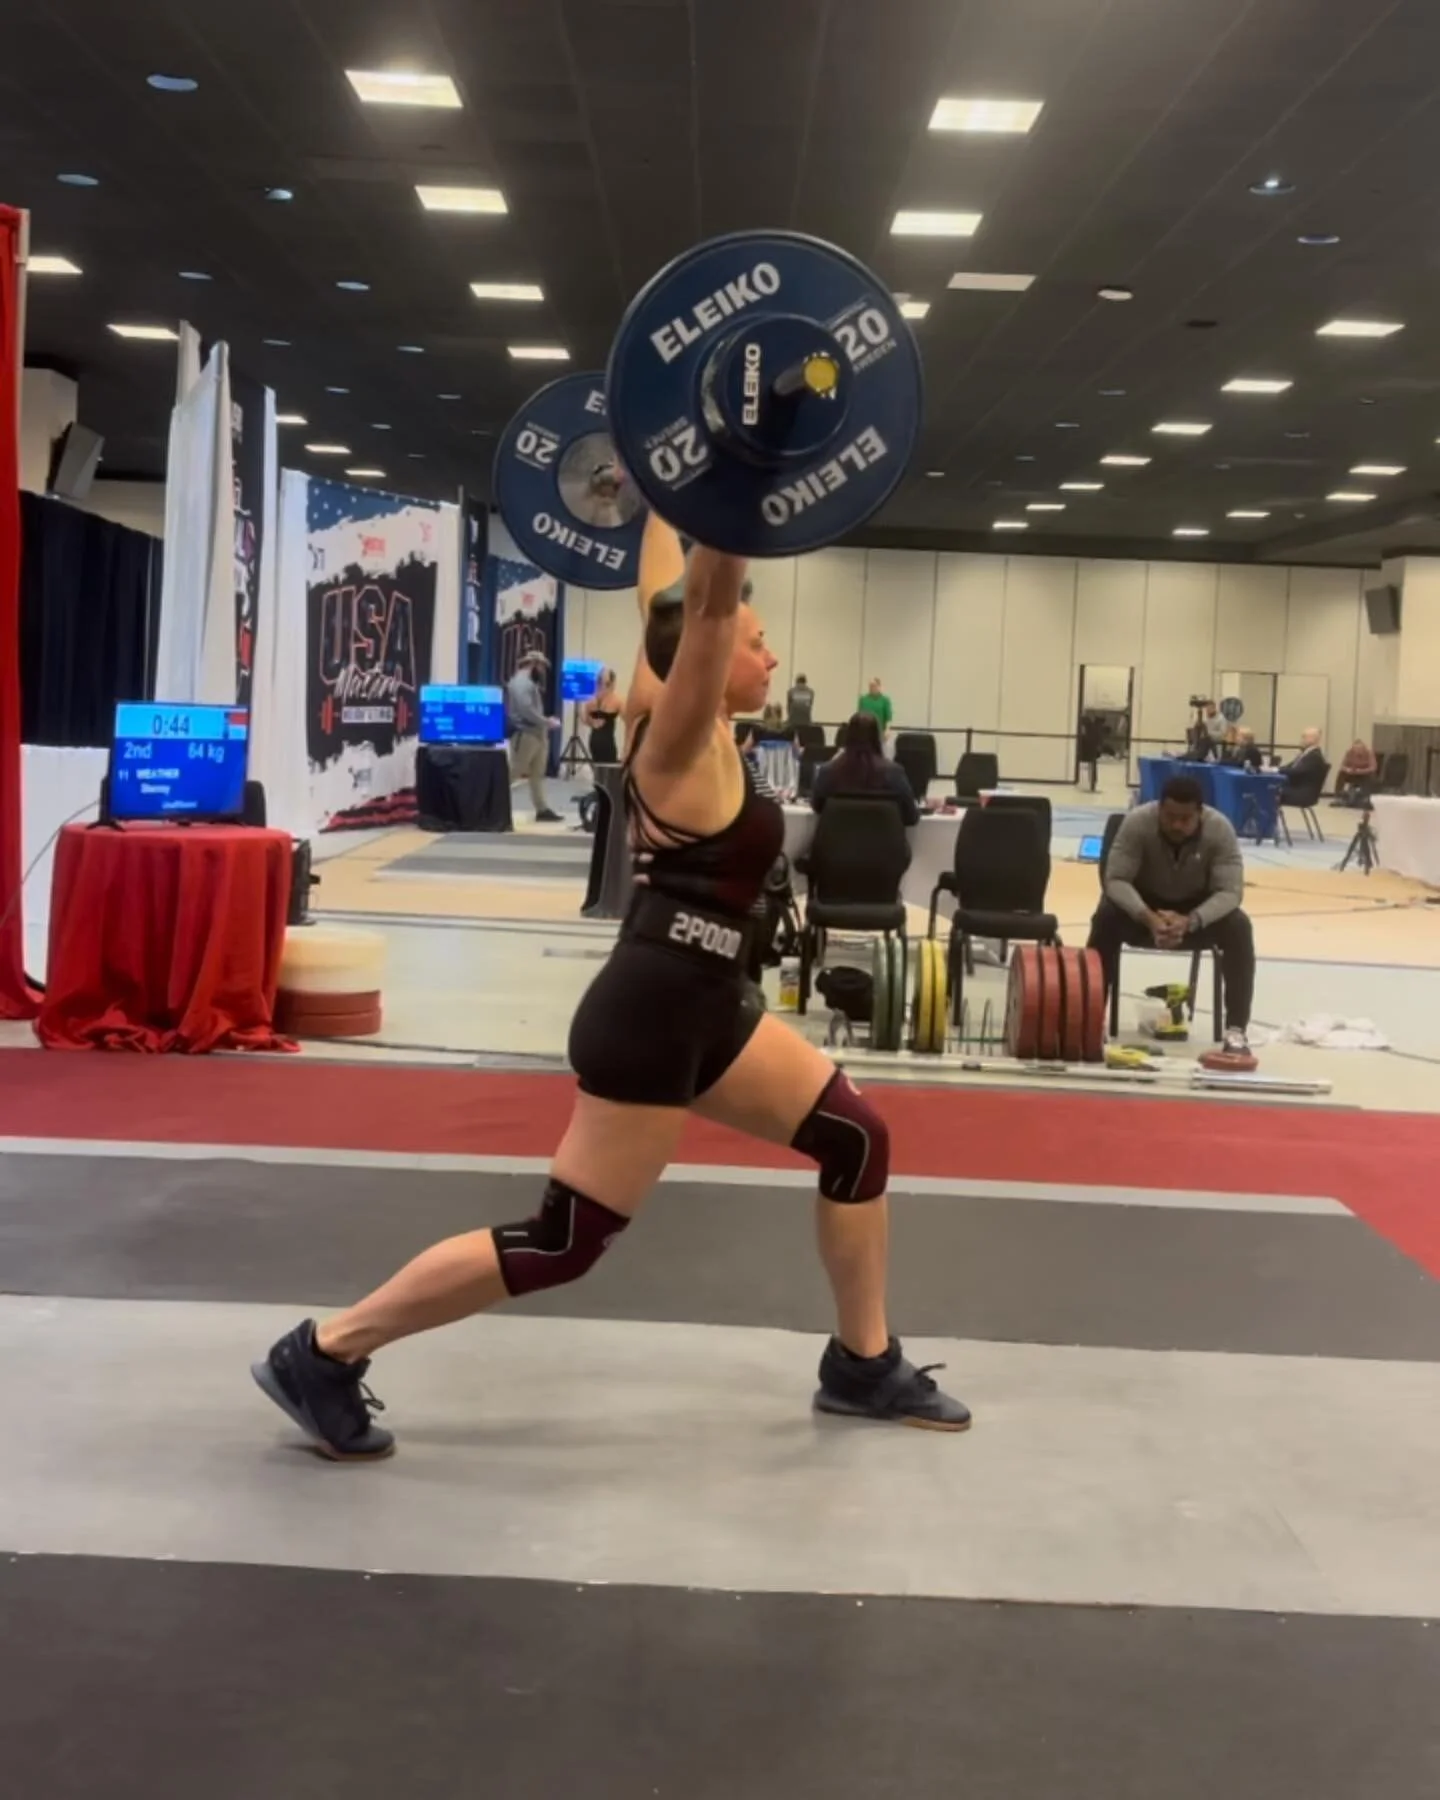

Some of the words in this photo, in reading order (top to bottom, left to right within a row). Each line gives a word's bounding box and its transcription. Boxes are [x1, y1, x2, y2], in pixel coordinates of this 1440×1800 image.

[650, 262, 781, 363] ELEIKO
[834, 308, 889, 361] 20
[742, 343, 762, 426] ELEIKO
[516, 430, 558, 464] 20
[649, 425, 708, 481] 20
[761, 425, 889, 526] ELEIKO
[532, 511, 628, 571] ELEIKO
[319, 584, 416, 693] USA
[123, 742, 153, 759] 2nd
[207, 743, 225, 763] kg
[153, 714, 190, 736] 0:44
